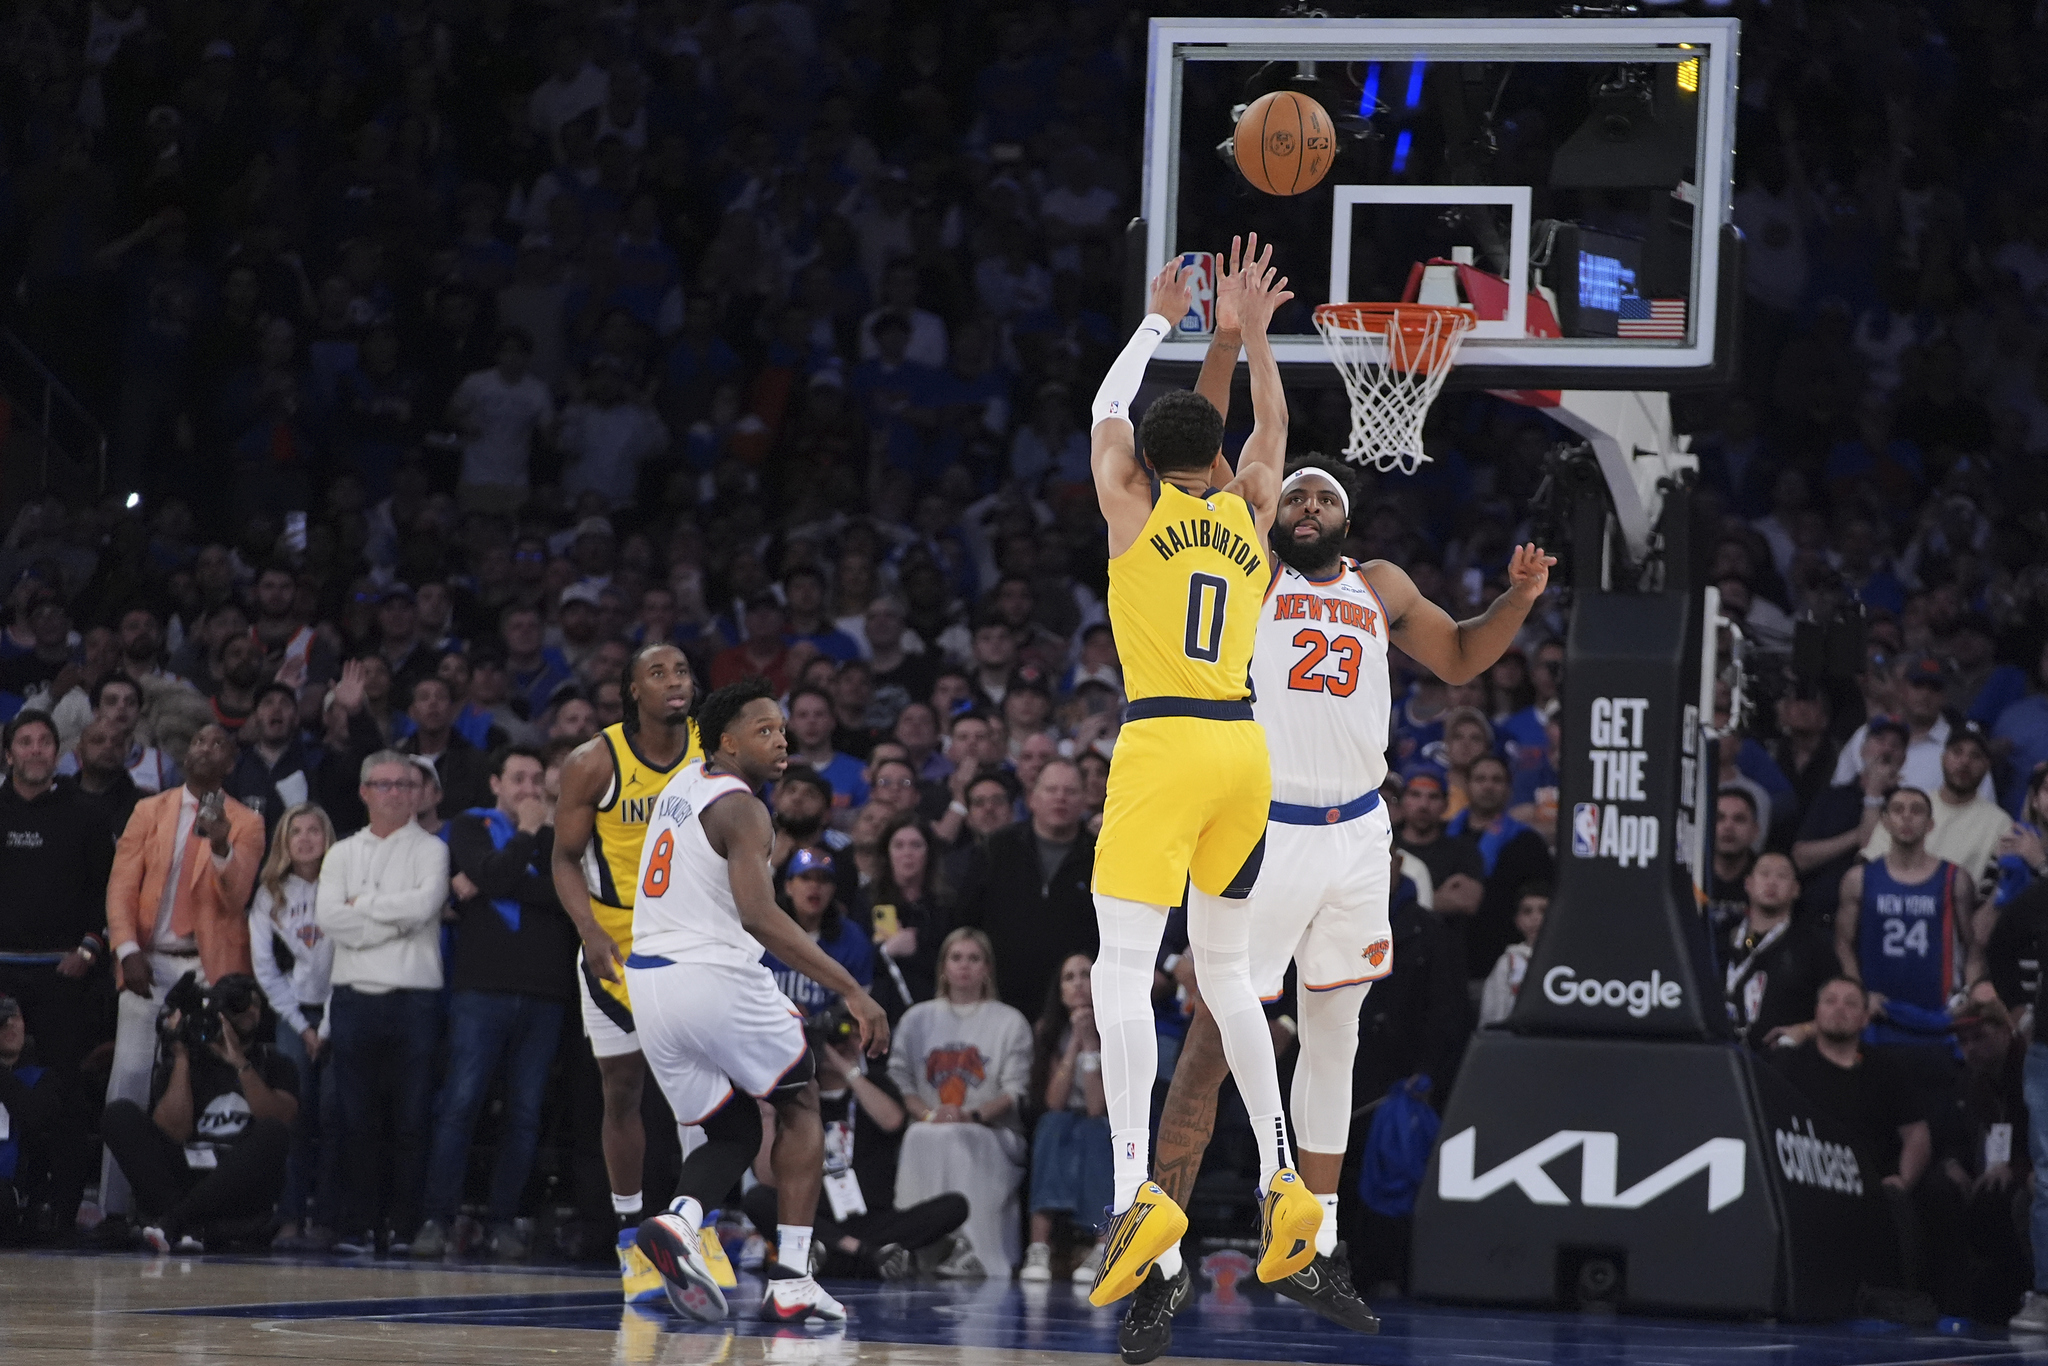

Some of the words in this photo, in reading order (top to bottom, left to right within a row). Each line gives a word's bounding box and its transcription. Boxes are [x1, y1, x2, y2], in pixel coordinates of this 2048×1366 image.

[1150, 519, 1261, 577] HALIBURTON
[1184, 570, 1228, 663] 0
[1274, 593, 1323, 621] NEW
[1322, 598, 1378, 638] YORK
[1287, 627, 1363, 698] 23
[1591, 697, 1649, 748] GET
[1589, 750, 1648, 801] THE
[642, 828, 675, 898] 8
[1599, 804, 1660, 868] App
[1905, 894, 1936, 917] YORK
[1882, 917, 1929, 957] 24
[1543, 965, 1682, 1018] Google
[1775, 1115, 1863, 1197] coinbase
